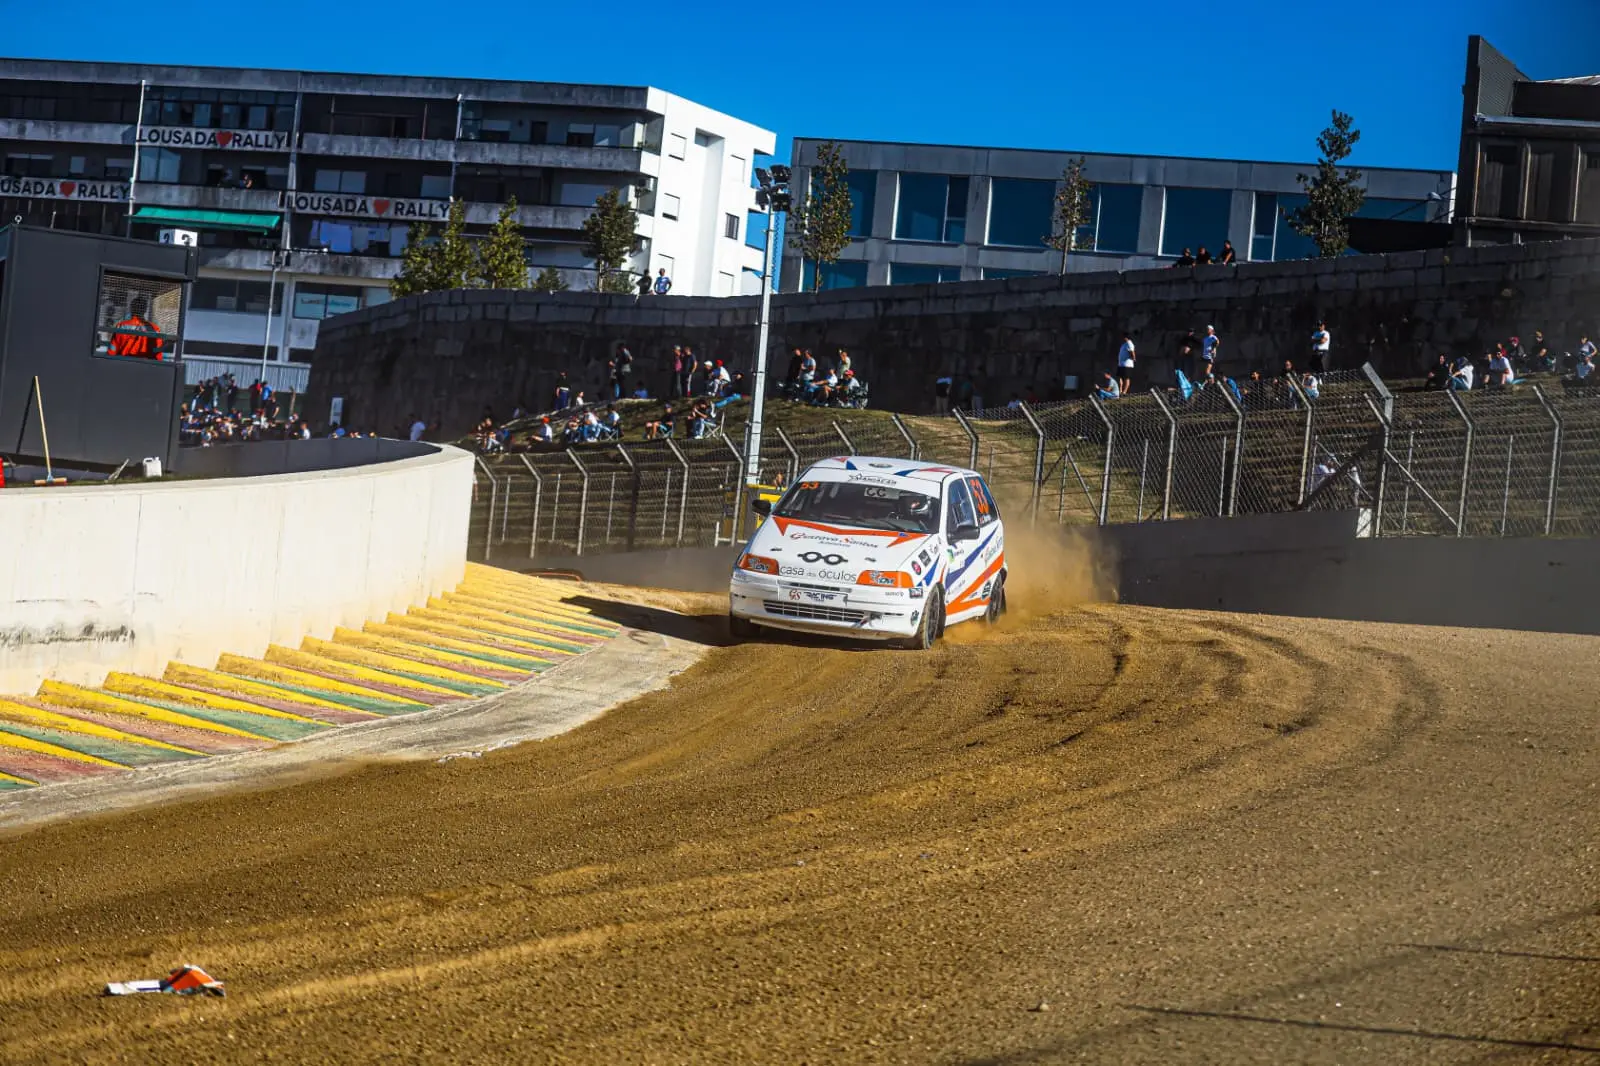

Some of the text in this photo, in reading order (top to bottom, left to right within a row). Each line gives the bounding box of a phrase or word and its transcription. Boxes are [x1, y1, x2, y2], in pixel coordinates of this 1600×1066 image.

[136, 127, 286, 149] LOUSADA RALLY
[78, 183, 130, 199] RALLY
[287, 195, 450, 218] LOUSADA RALLY
[779, 565, 805, 576] casa
[818, 569, 857, 583] óculos
